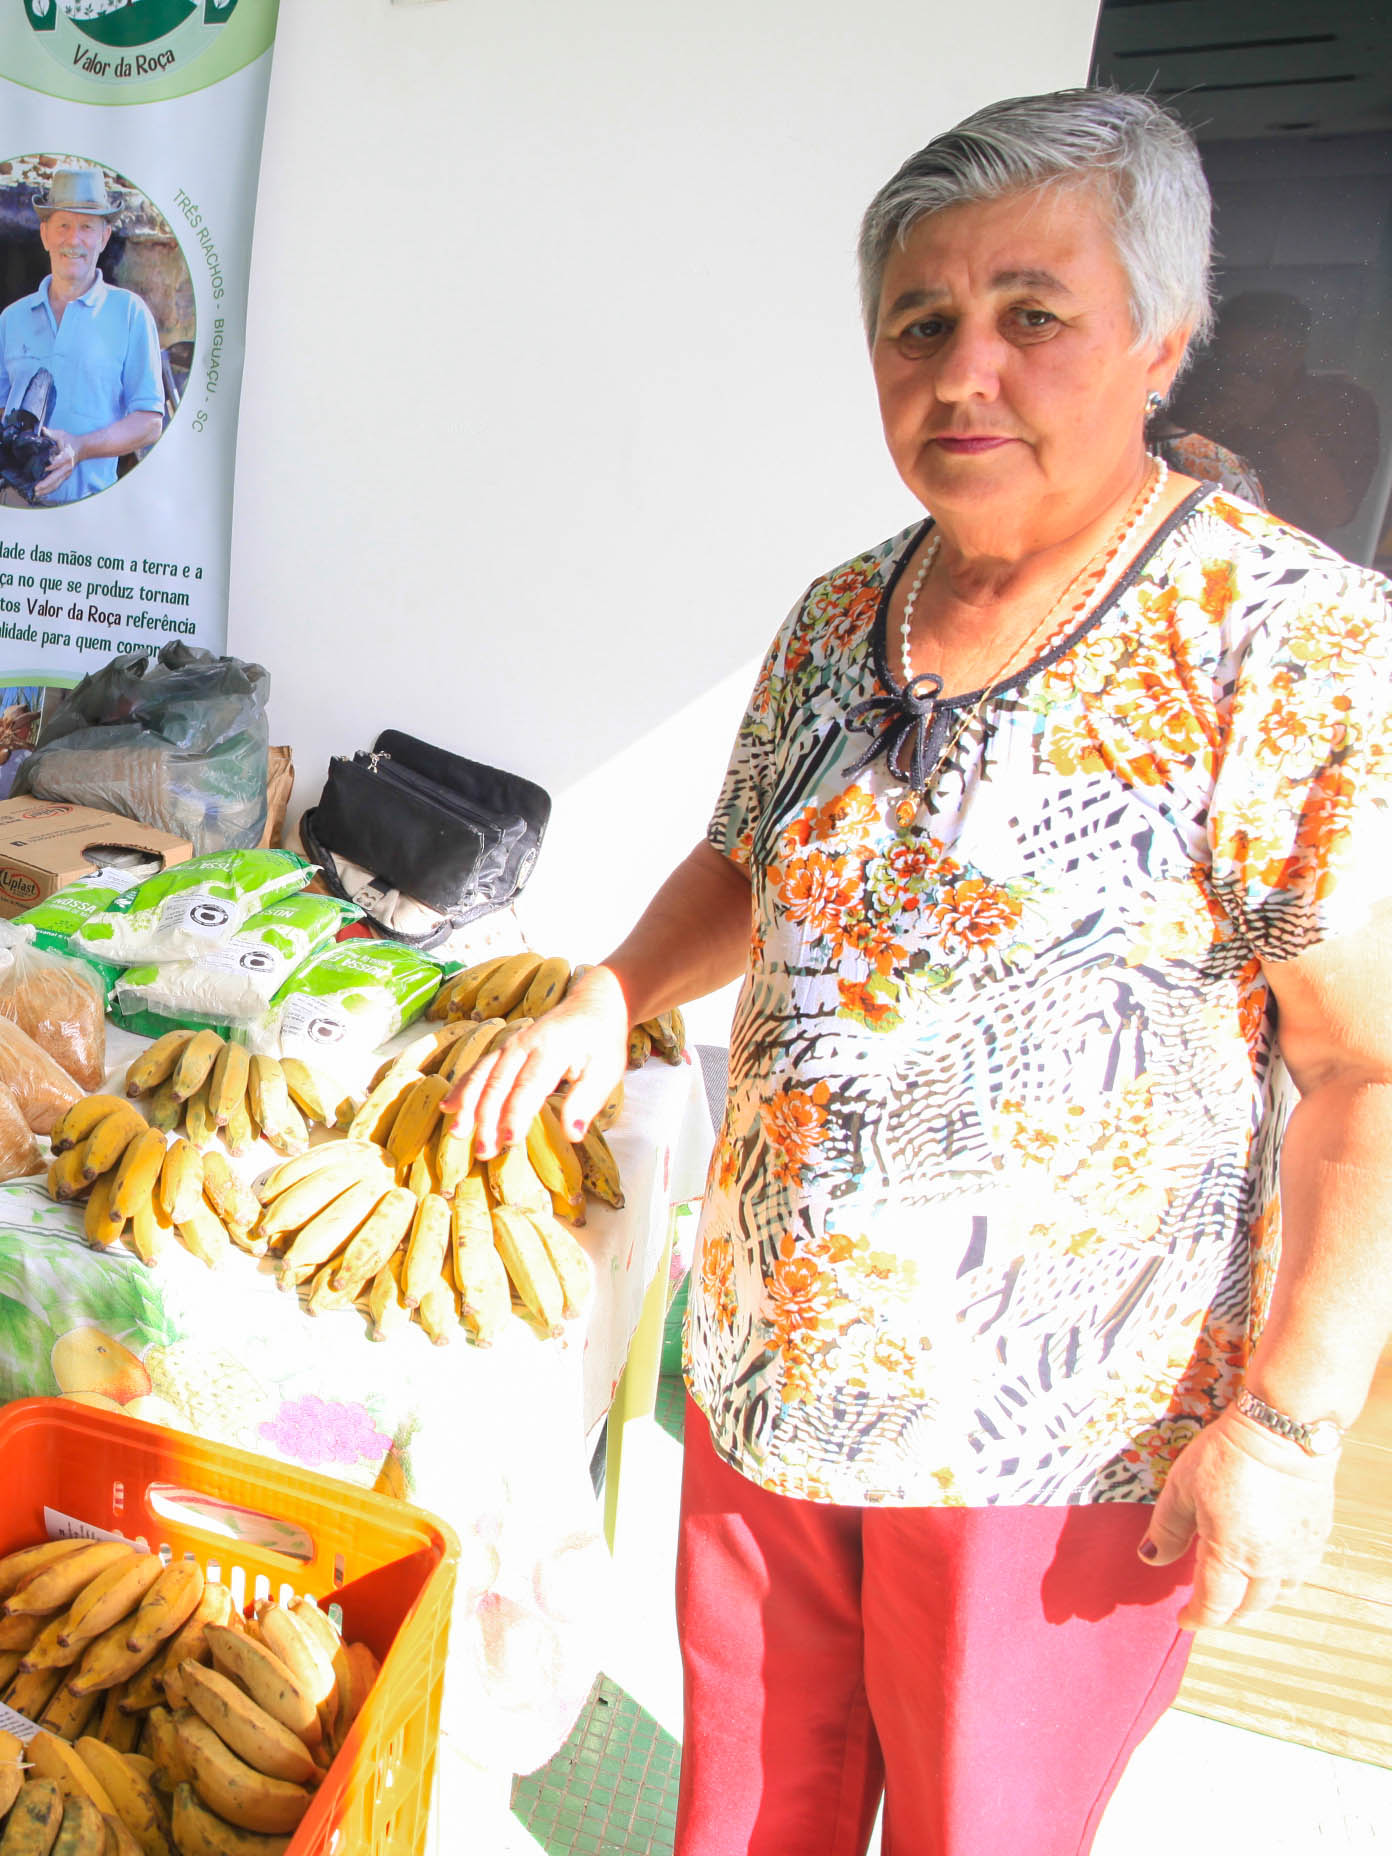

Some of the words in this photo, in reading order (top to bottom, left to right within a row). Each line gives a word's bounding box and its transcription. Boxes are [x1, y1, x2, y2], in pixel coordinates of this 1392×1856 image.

[73, 44, 110, 76] Valor
[114, 57, 131, 78] da
[136, 50, 175, 76] Roça
[173, 188, 203, 228] TRÊS
[196, 227, 224, 300] RIACHOS
[206, 319, 224, 393] BIGUAÇU
[191, 410, 208, 433] SC
[30, 544, 52, 563] das
[58, 550, 92, 567] mãos
[97, 556, 124, 571] com
[130, 560, 137, 572] a
[143, 559, 178, 577] terra
[183, 565, 190, 578] e
[195, 567, 202, 579] a
[18, 575, 34, 588] no
[39, 577, 62, 594] que
[67, 580, 82, 593] se
[86, 580, 133, 600] produz
[140, 586, 189, 606] tornam
[27, 598, 63, 618] Valor
[68, 603, 83, 621] da
[88, 605, 121, 627] Roça
[126, 611, 196, 635] referência
[41, 630, 71, 648] para
[76, 634, 111, 653] quem
[117, 641, 160, 657] compr
[3, 872, 36, 895] Liplast
